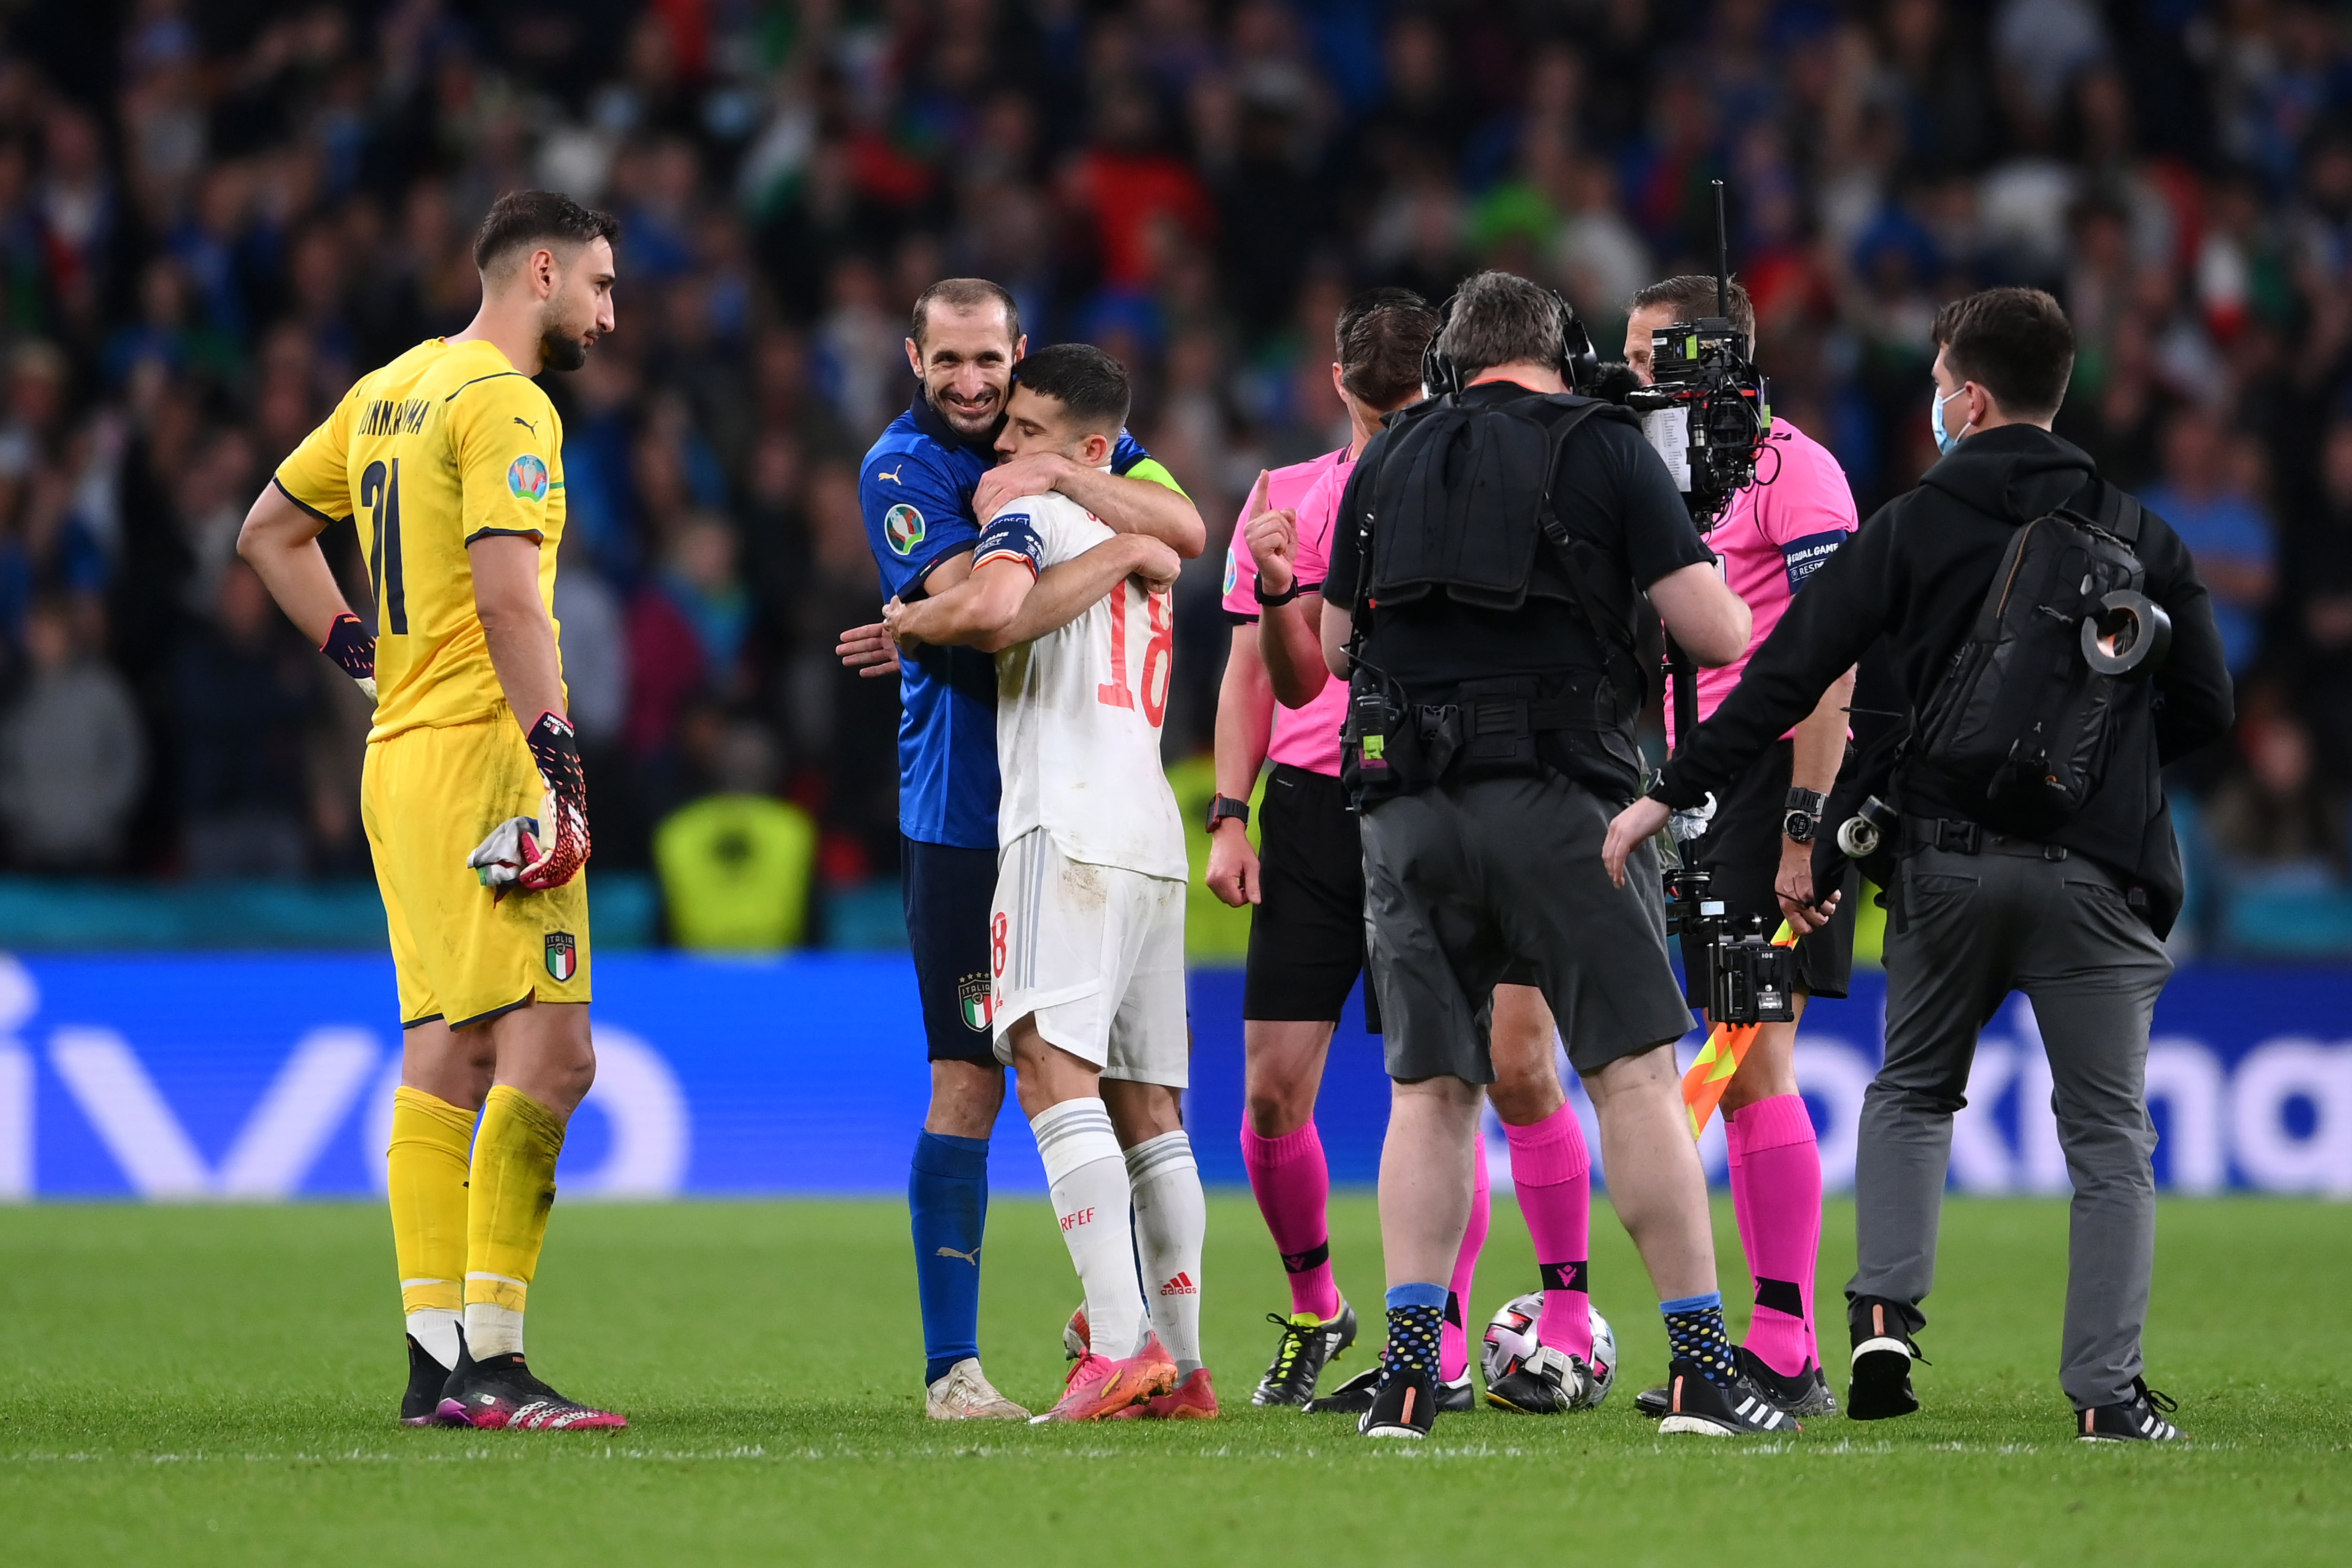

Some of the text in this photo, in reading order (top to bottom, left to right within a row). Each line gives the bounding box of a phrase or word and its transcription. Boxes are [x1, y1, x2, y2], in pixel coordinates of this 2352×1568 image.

[361, 458, 409, 635] 21
[1787, 549, 1813, 566] #EQUAL
[1799, 561, 1824, 575] RESP
[1098, 579, 1173, 728] 18
[547, 935, 573, 945] ITALIA
[962, 984, 990, 995] ITALIA
[1060, 1207, 1095, 1233] RFEF
[1160, 1286, 1196, 1296] adidas
